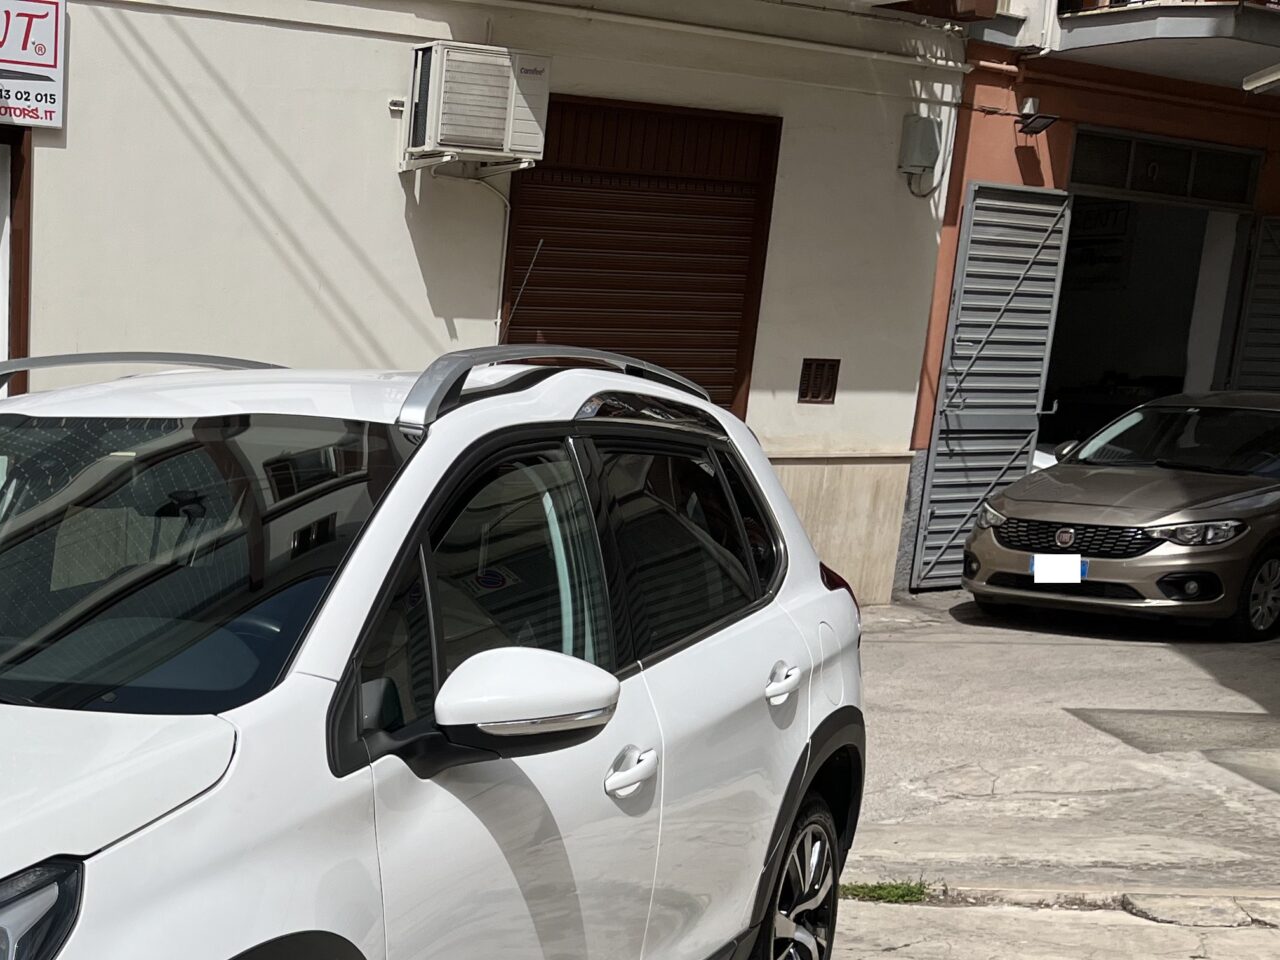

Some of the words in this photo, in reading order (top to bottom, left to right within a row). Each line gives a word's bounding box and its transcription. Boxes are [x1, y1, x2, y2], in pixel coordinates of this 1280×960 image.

[0, 89, 10, 99] 13
[15, 90, 31, 101] 02
[35, 93, 56, 104] 015
